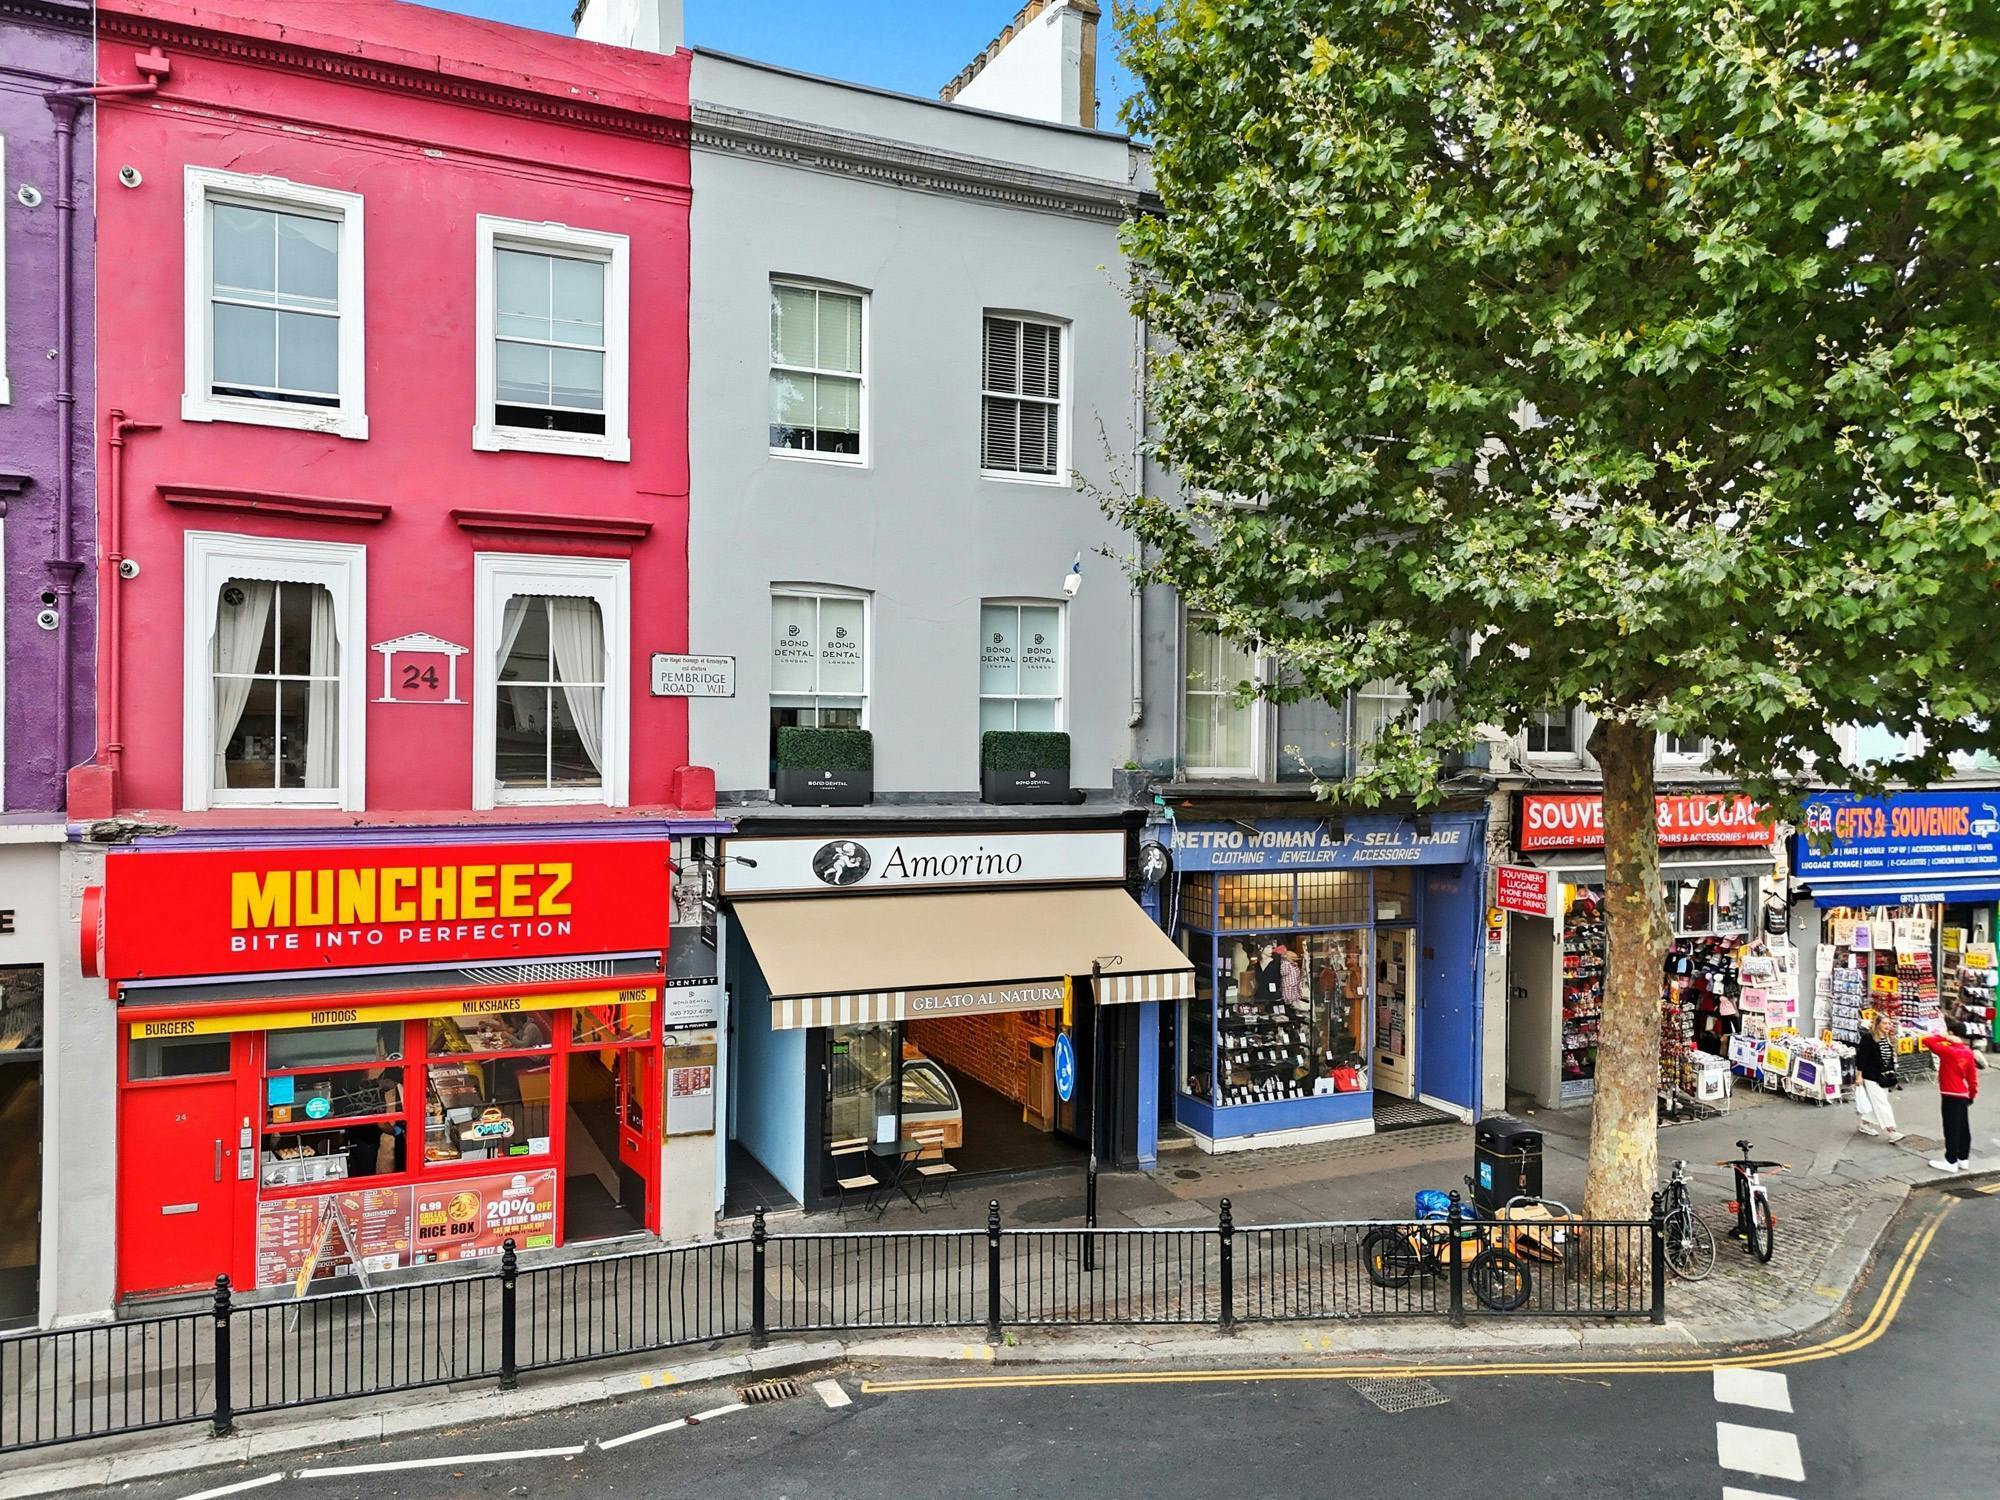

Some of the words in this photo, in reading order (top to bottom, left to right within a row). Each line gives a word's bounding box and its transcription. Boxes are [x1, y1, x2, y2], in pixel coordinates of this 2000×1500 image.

[780, 639, 809, 647] BOND
[827, 641, 856, 649] BOND
[774, 649, 814, 657] DENTAL
[1027, 647, 1052, 655] BOND
[402, 665, 440, 689] 24
[661, 672, 727, 684] PEMBRIDGE
[1657, 802, 1672, 827] &
[1891, 806, 1970, 838] SOUVENIRS
[1171, 831, 1244, 849] RETRO
[1248, 831, 1316, 848] WOMAN
[1364, 832, 1402, 846] SELL
[1528, 835, 1574, 846] LUGGAGE
[1689, 832, 1741, 842] ACCESSORIES
[1746, 831, 1769, 840] VAPES
[880, 845, 1022, 879] Amorino
[1211, 851, 1265, 864] CLOTHING
[1278, 850, 1337, 863] JEWELLERY
[1352, 848, 1421, 861] ACCESSORIES
[1802, 861, 1831, 869] LUGGAGE
[1502, 870, 1544, 883] SOUVENIERS
[1507, 880, 1540, 892] LUGGAGE
[231, 863, 573, 929] MUNCHEEZ
[1500, 888, 1522, 897] PHONE
[1523, 891, 1547, 901] REPAIRS
[1506, 896, 1521, 906] SOFT
[1523, 899, 1546, 910] DRINKS
[231, 933, 299, 952] BITE
[315, 929, 384, 948] INTO
[399, 921, 572, 944] PERFECTION
[668, 978, 715, 987] DENTIST
[1874, 978, 1896, 989] £1
[618, 989, 647, 1002] WINGS
[912, 993, 974, 1011] GELATO
[977, 992, 996, 1006] AL
[462, 999, 521, 1013] MILKSHAKES
[311, 1010, 357, 1024] HOTDOGS
[145, 1021, 195, 1036] BURGERS
[486, 1198, 536, 1219] 20%
[536, 1201, 552, 1212] OFF
[487, 1218, 501, 1229] THE
[503, 1215, 529, 1226] ENTIRE
[530, 1212, 552, 1222] MENU
[420, 1225, 446, 1239] RICE
[451, 1222, 475, 1235] BOX
